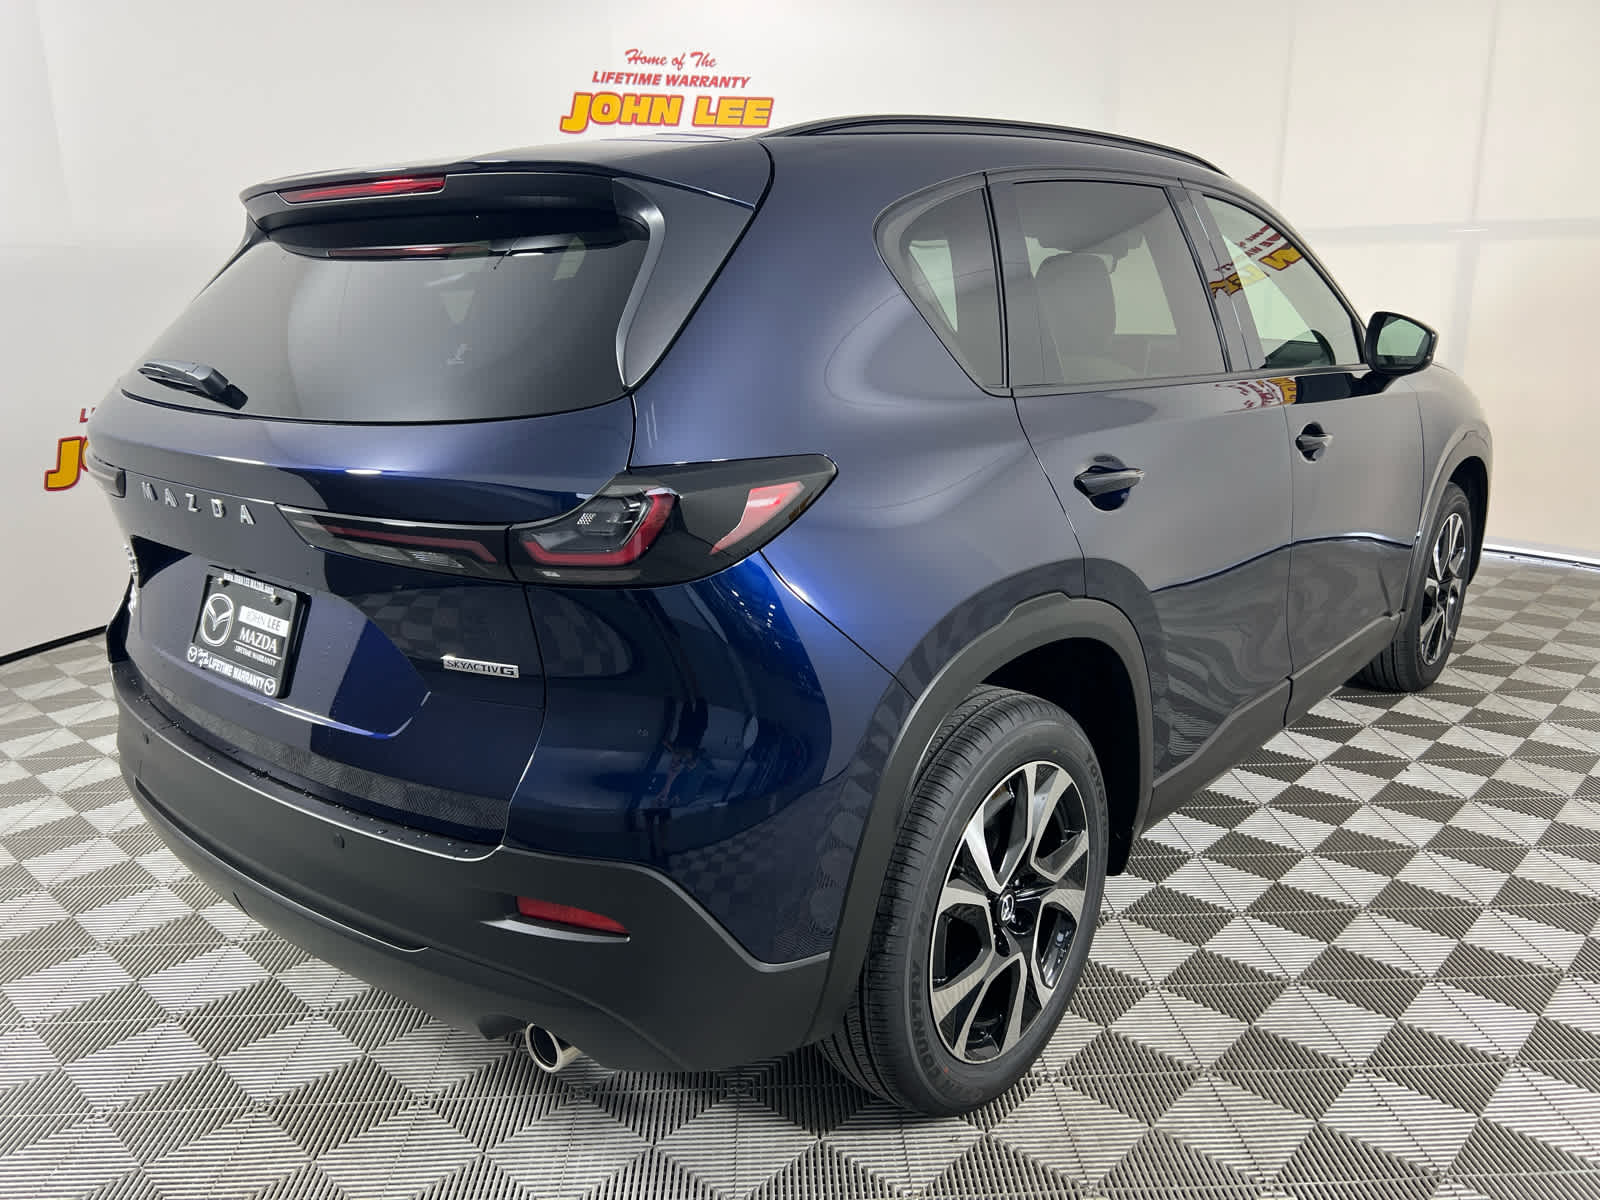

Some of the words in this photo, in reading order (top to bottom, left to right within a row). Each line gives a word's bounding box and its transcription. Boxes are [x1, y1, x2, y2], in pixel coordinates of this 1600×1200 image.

[625, 48, 667, 66] Home
[671, 53, 687, 70] of
[690, 51, 717, 68] The
[592, 70, 661, 87] LIFETIME
[666, 74, 751, 89] WARRANTY
[559, 91, 685, 134] JOHN
[691, 95, 774, 129] LEE
[141, 481, 256, 526] MAZDA
[267, 615, 282, 631] LEE
[239, 626, 278, 654] MAZDA
[208, 656, 234, 677] LIFETIME
[232, 667, 265, 689] WARRANTY
